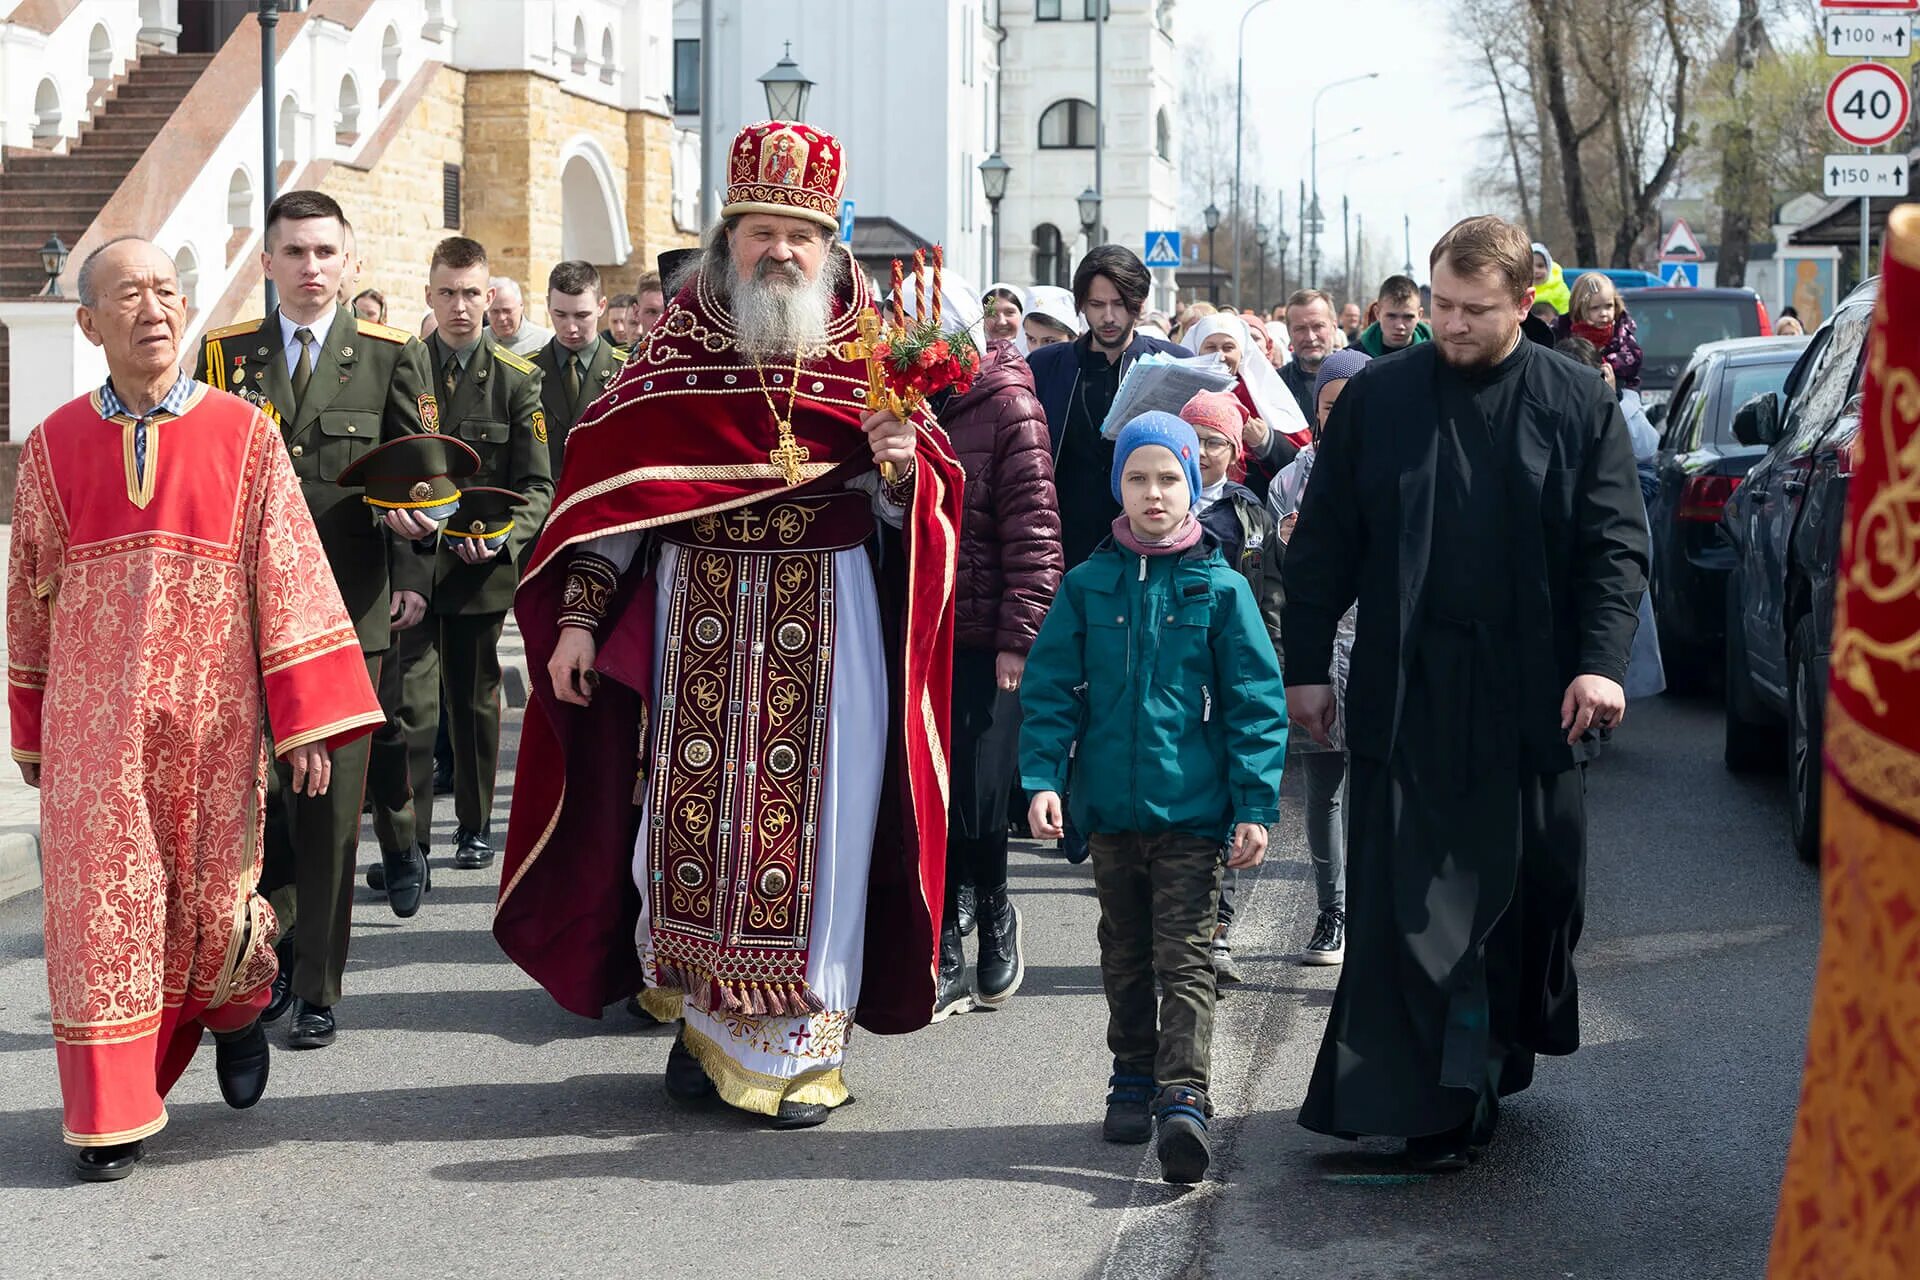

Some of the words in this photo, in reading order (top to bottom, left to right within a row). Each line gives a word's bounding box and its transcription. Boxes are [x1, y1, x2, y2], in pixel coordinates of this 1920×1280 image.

[1846, 28, 1875, 42] 100
[1843, 89, 1891, 120] 40
[1842, 168, 1870, 183] 150
